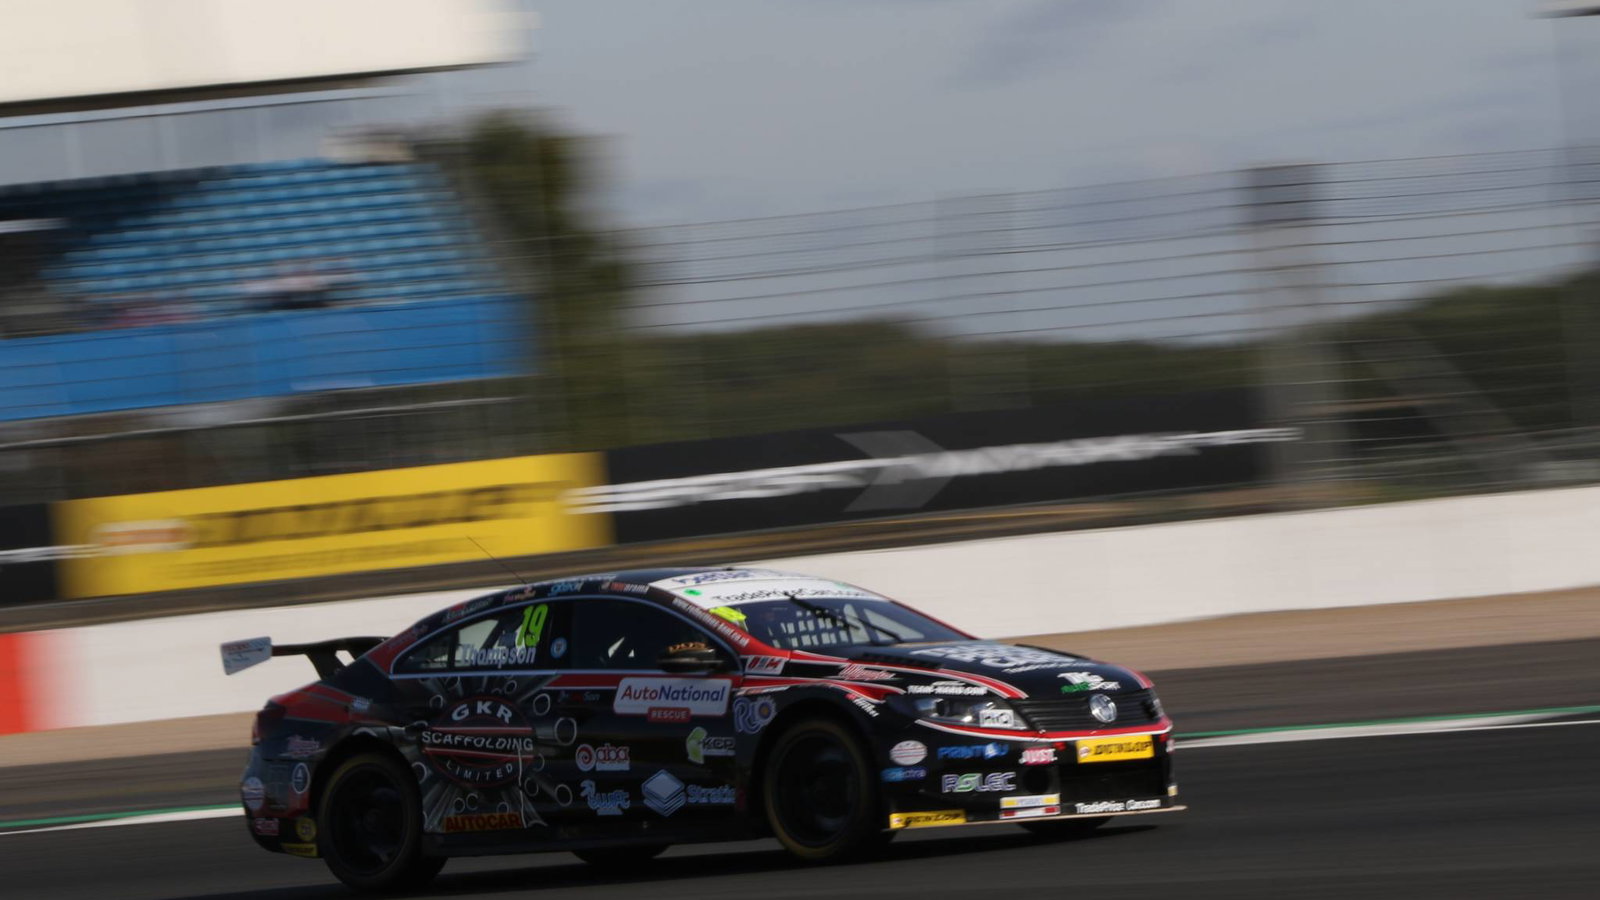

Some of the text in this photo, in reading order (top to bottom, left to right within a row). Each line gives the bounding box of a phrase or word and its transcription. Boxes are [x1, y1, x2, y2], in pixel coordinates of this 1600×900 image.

[516, 603, 550, 647] 19
[459, 645, 538, 669] Thompson
[621, 685, 727, 703] AutoNational
[451, 700, 514, 725] GKR
[650, 711, 689, 721] RESCUE
[421, 731, 534, 752] SCAFFOLDING
[1093, 741, 1152, 755] DUNLOP
[446, 759, 514, 782] LIMITED
[445, 813, 522, 832] AUTOCAR
